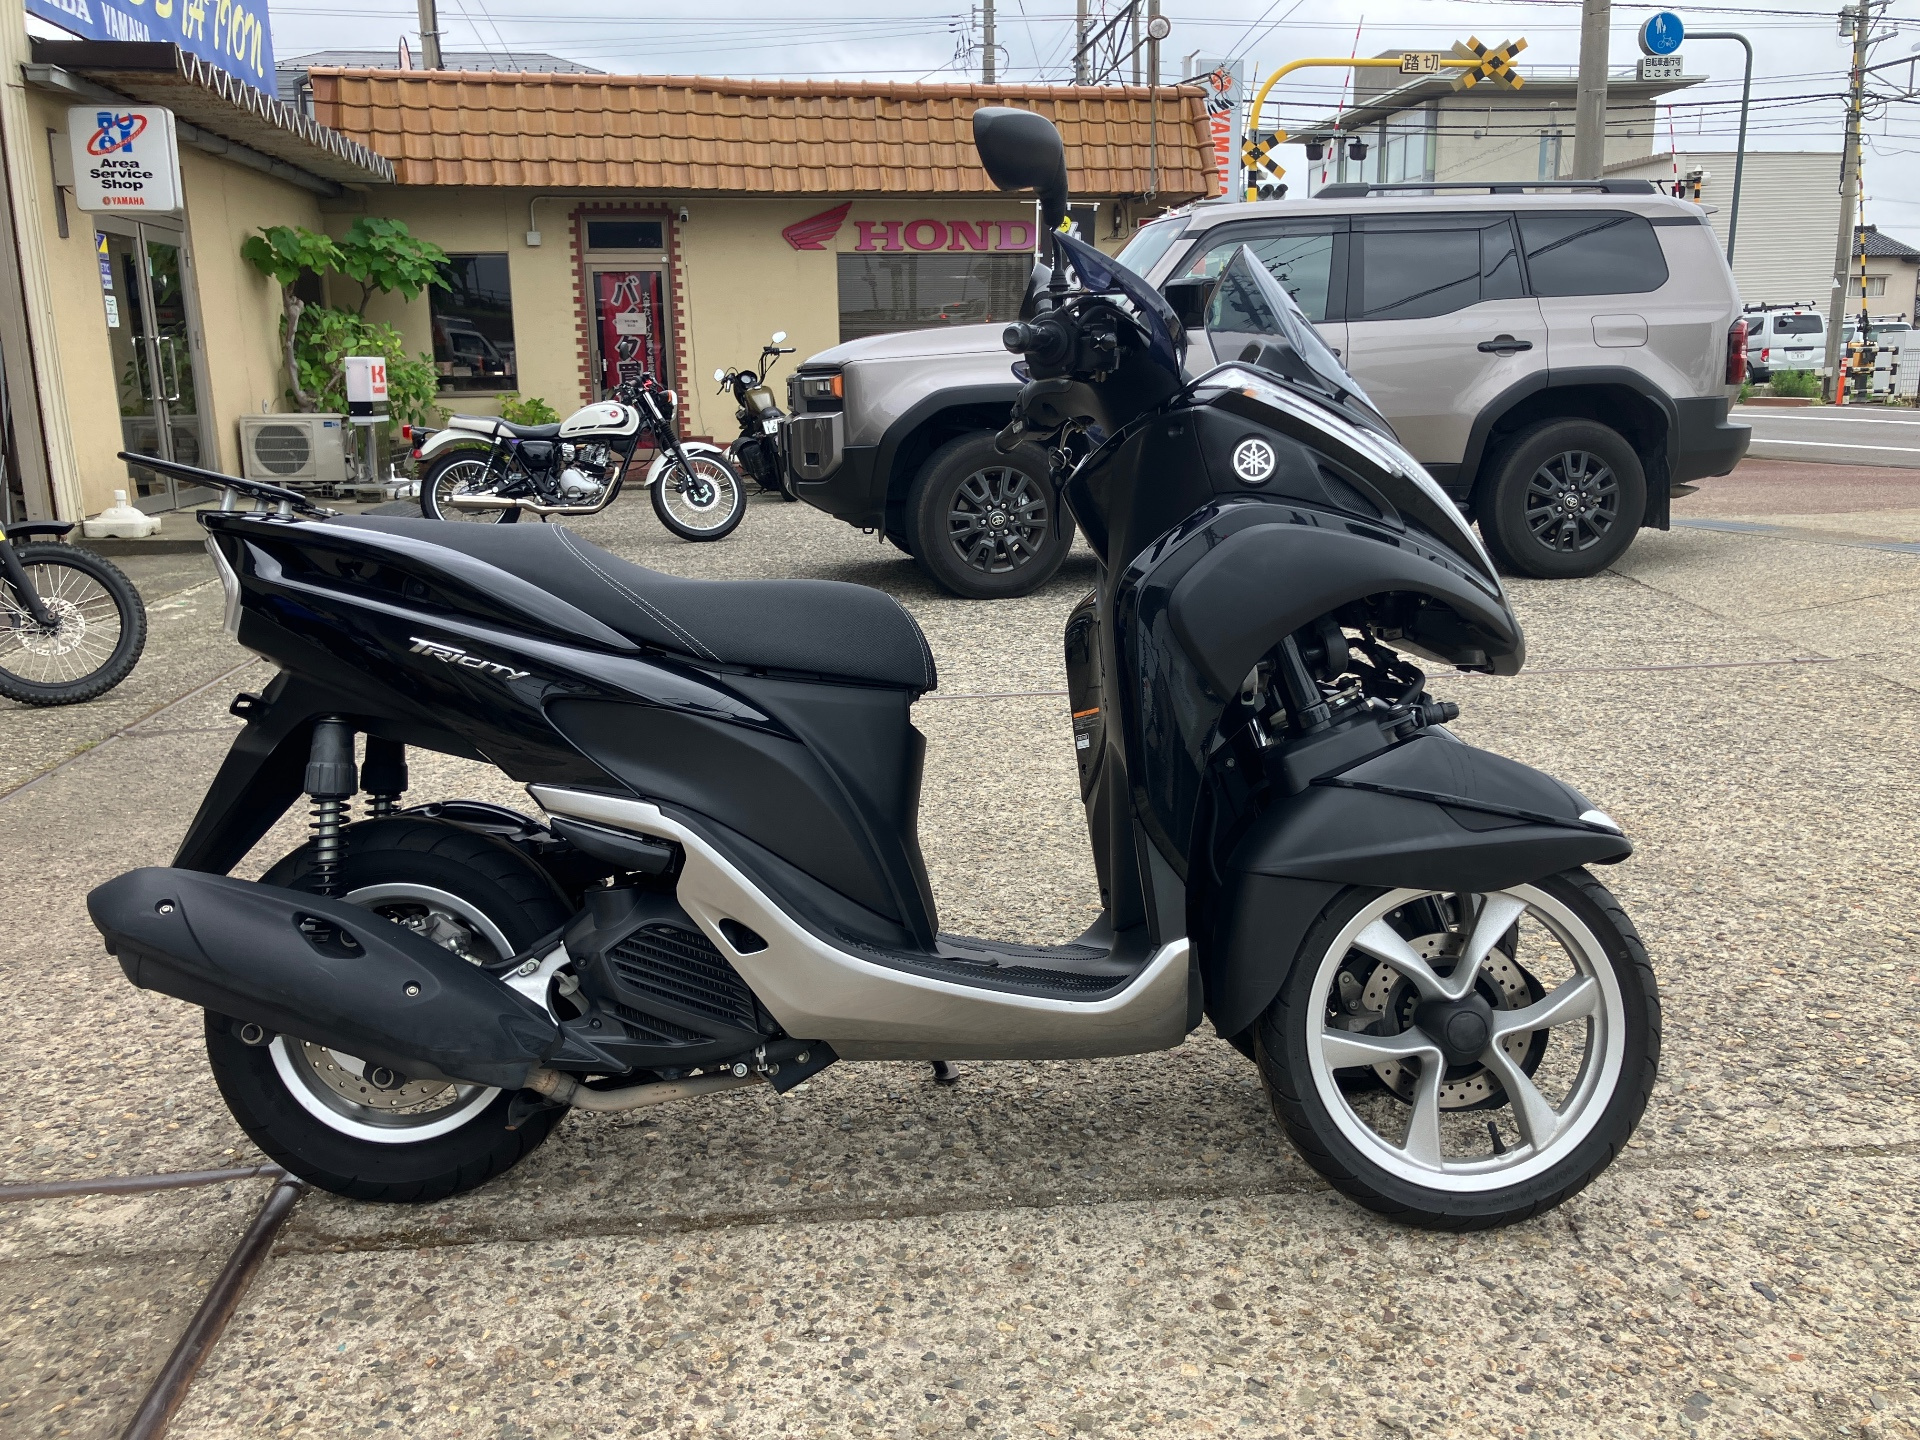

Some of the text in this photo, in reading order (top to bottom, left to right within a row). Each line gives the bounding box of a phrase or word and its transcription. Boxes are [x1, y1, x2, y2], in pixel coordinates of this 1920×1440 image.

[1404, 54, 1439, 71] 踏切
[1645, 57, 1681, 67] 自転車通行可
[1644, 69, 1681, 78] ここまで
[100, 158, 140, 168] Area
[90, 168, 153, 179] Service
[101, 179, 144, 191] Shop
[112, 196, 145, 206] YAMAHA
[854, 219, 1040, 251] HOND
[409, 636, 531, 680] TRICITY
